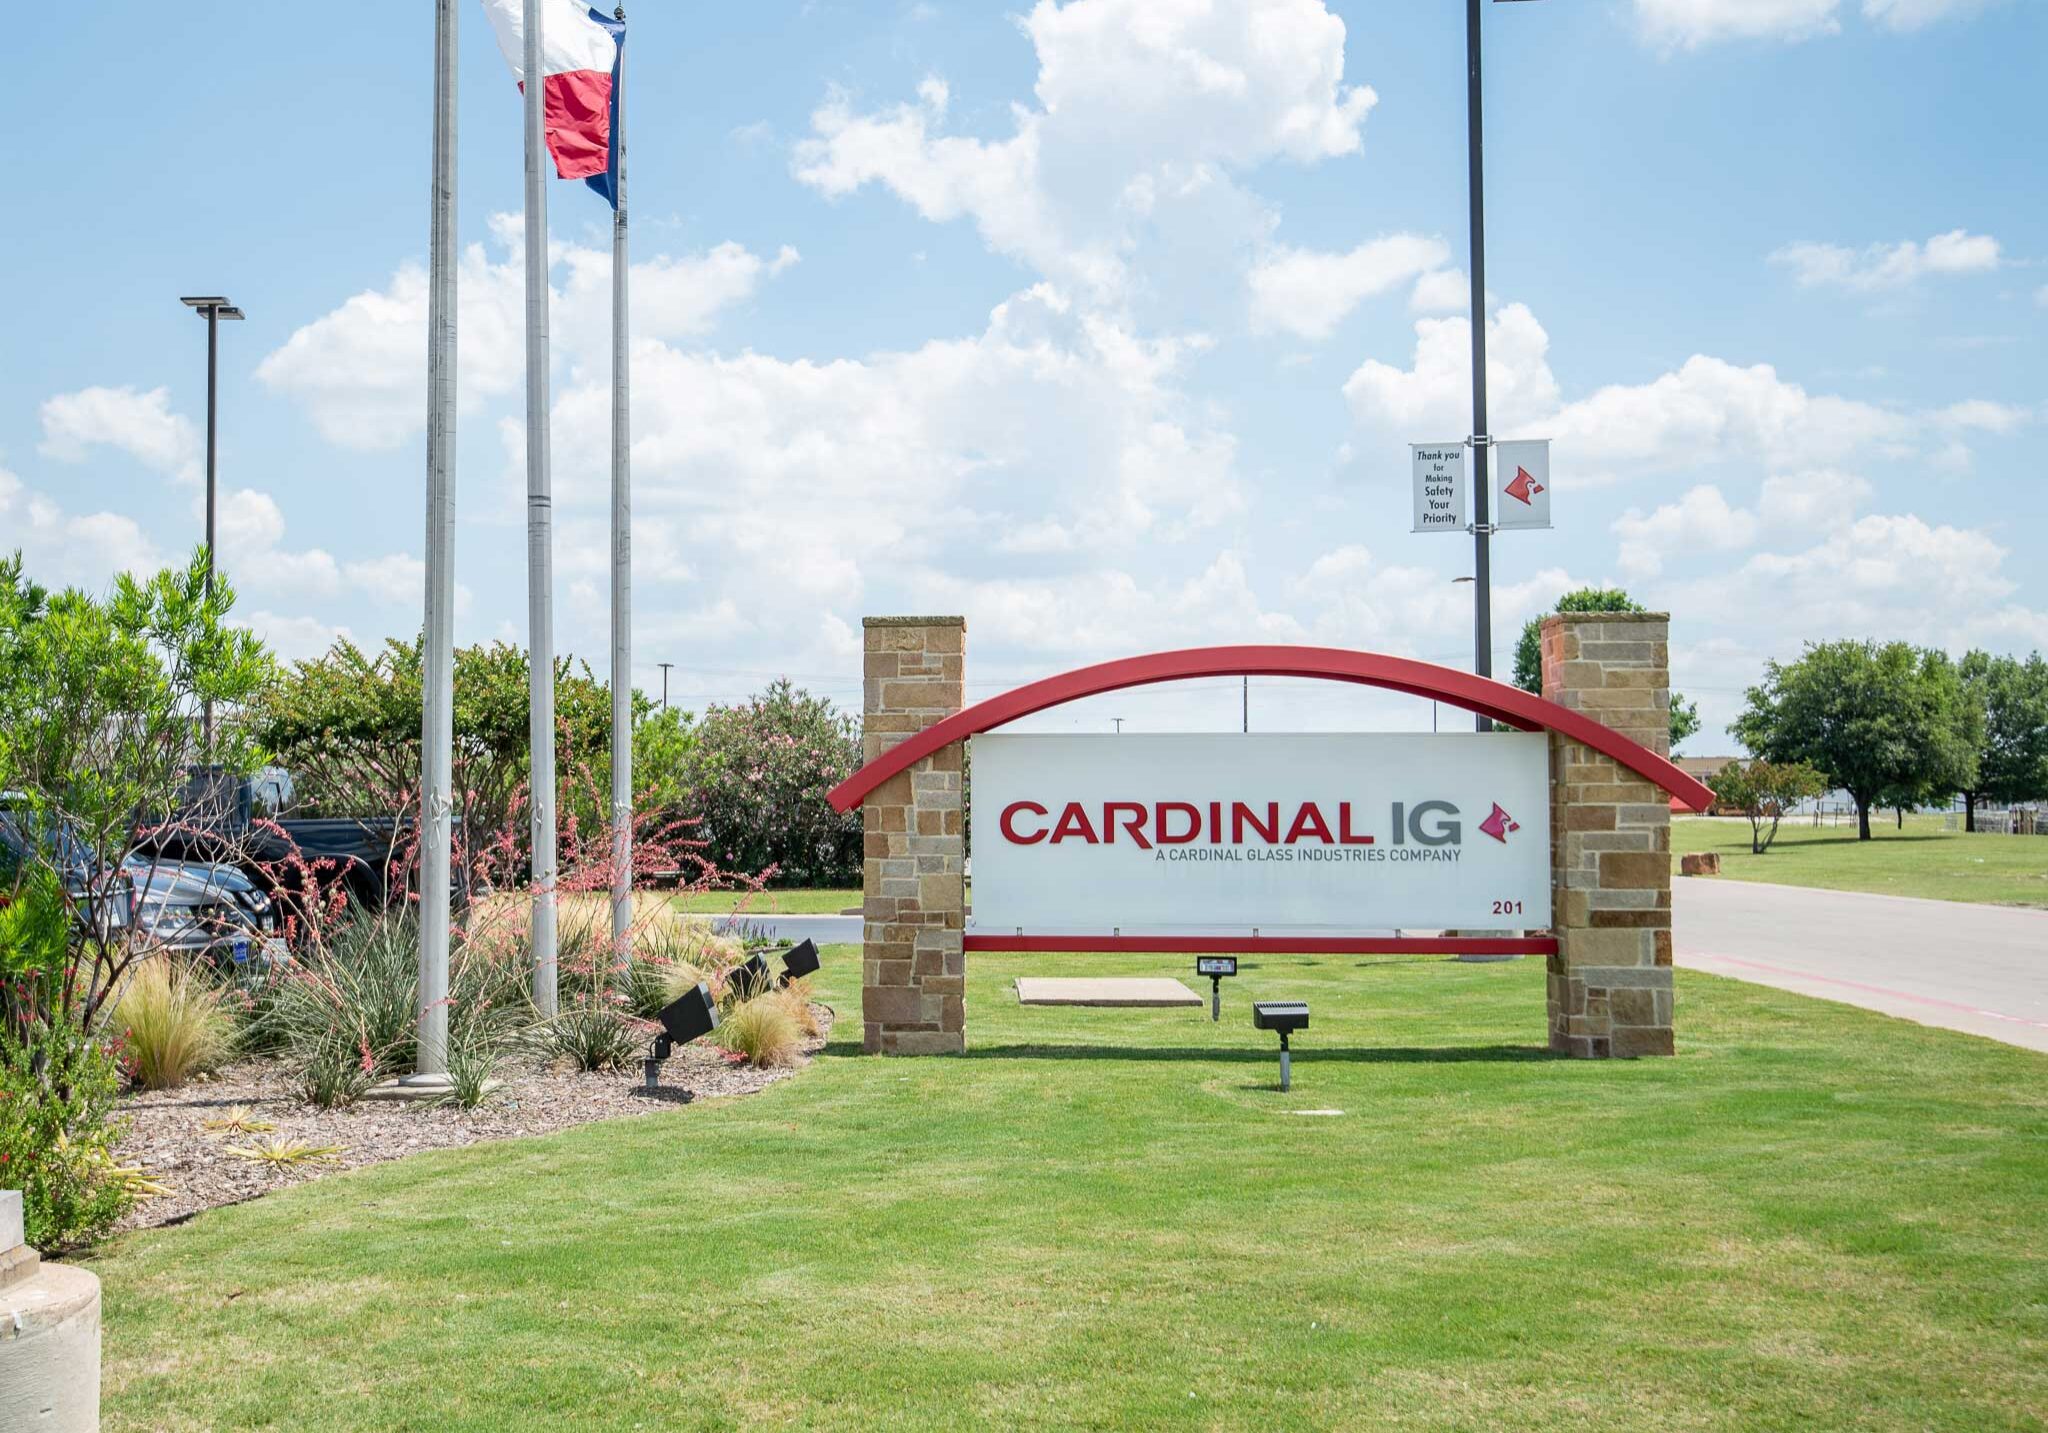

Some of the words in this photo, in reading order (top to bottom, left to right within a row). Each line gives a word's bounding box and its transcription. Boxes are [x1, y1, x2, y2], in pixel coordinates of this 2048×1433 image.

[1417, 451, 1442, 460] Thank
[1444, 452, 1460, 461] you
[1433, 463, 1444, 471] for
[1425, 474, 1453, 483] Making
[1425, 486, 1454, 497] Safety
[1429, 500, 1450, 509] Your
[1423, 513, 1457, 524] Priority
[999, 801, 1375, 850] CARDINAL
[1392, 800, 1462, 846] IG
[1155, 848, 1166, 862] A
[1169, 848, 1243, 862] CARDINAL
[1247, 848, 1293, 862] GLASS
[1298, 848, 1385, 862] INDUSTRIES
[1390, 848, 1462, 862] COMPANY
[1492, 900, 1524, 915] 201
